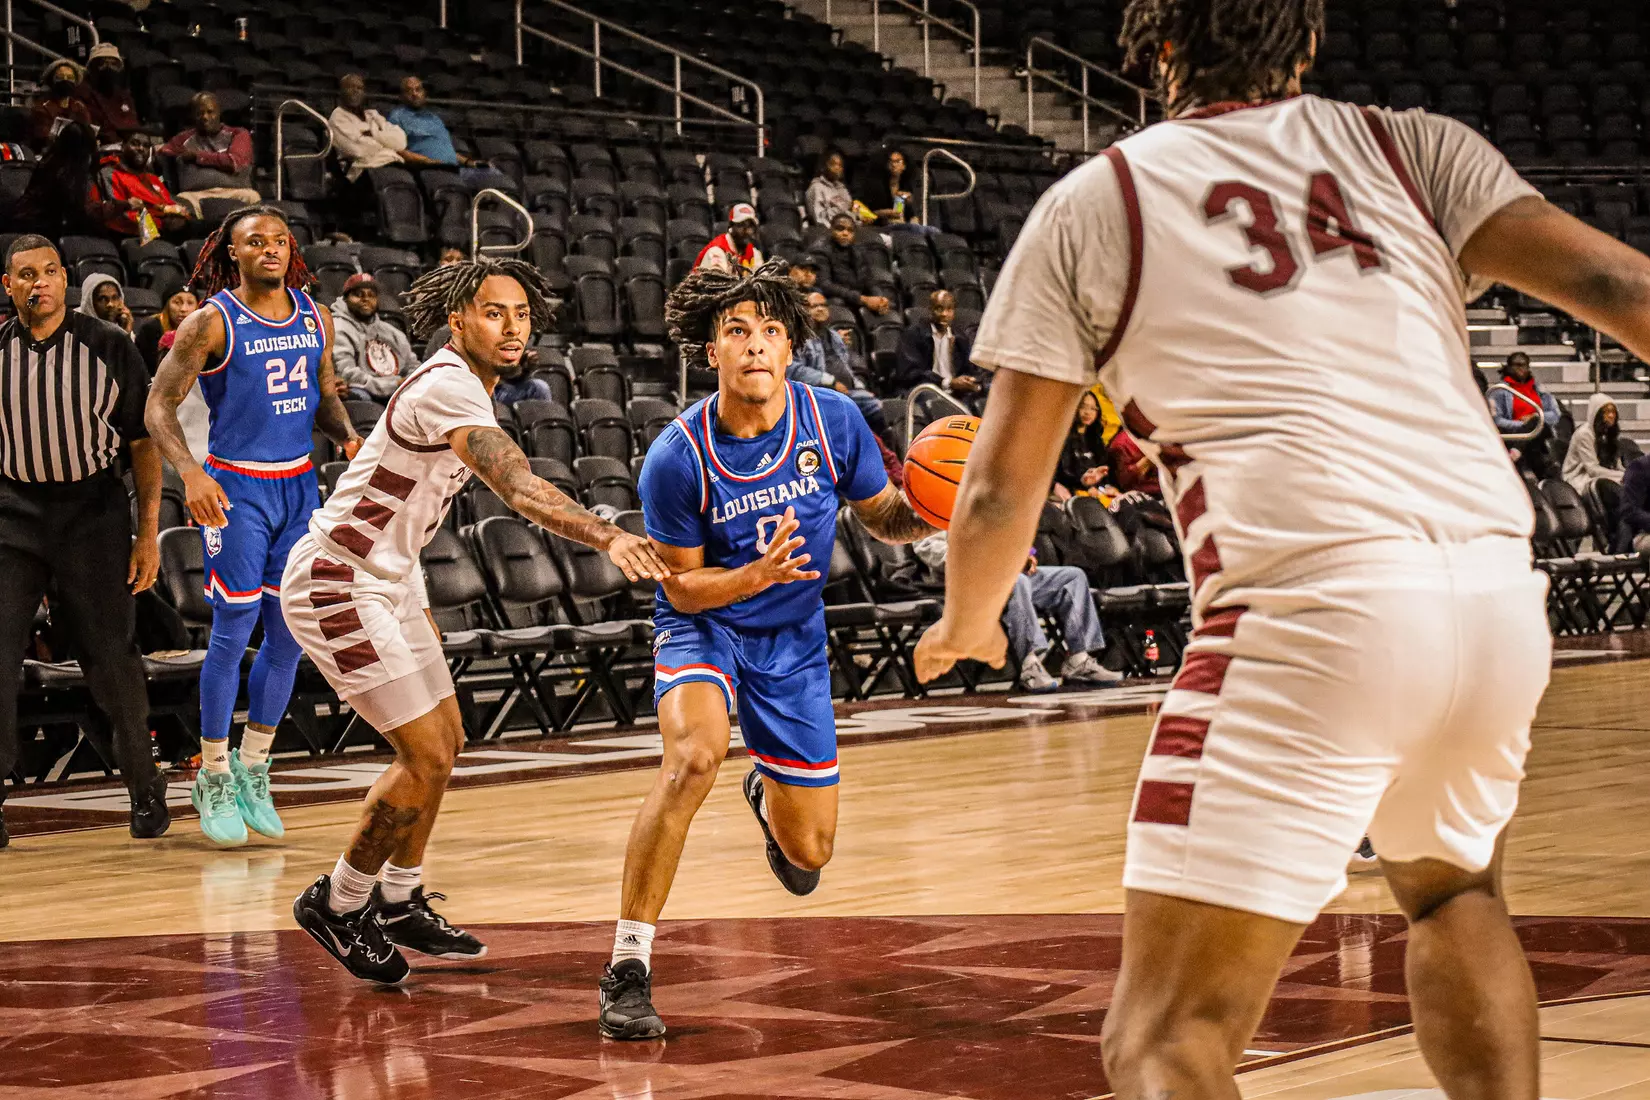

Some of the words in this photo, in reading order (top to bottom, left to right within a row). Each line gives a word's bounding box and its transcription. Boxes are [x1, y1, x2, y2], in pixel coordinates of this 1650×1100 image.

[1199, 170, 1391, 300] 34
[244, 334, 319, 355] LOUISIANA
[265, 355, 309, 394] 24
[272, 397, 307, 415] TECH
[712, 475, 820, 524] LOUISIANA
